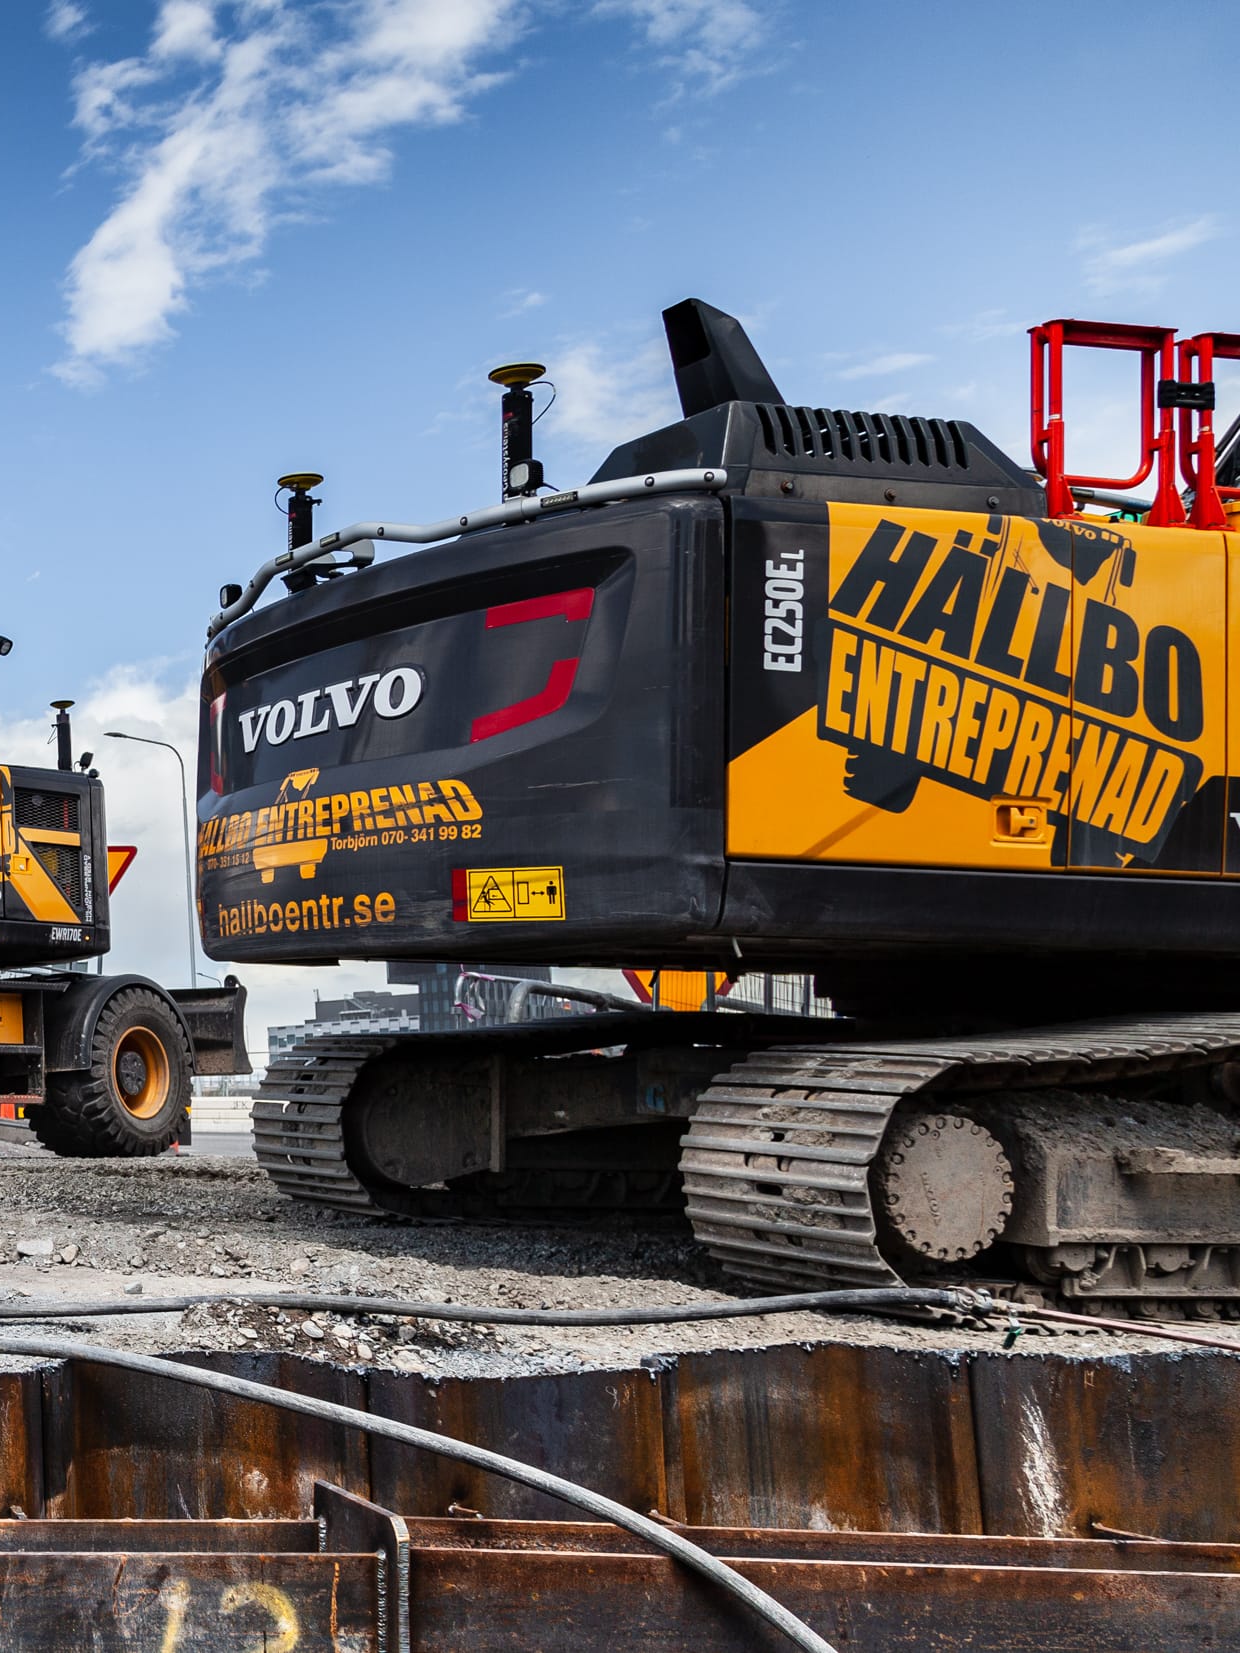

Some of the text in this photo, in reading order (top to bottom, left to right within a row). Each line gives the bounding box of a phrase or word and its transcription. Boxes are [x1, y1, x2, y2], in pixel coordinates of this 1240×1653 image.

[828, 519, 1203, 742] HÄLLBO
[238, 667, 423, 753] VOLVO
[825, 627, 1185, 843] ENTREPRENAD
[254, 779, 483, 845] ENTREPRENAD
[330, 824, 482, 852] Torbjörn 070- 341 99 82
[232, 853, 240, 866] 15
[241, 851, 249, 865] 12
[51, 927, 82, 942] EWR170E
